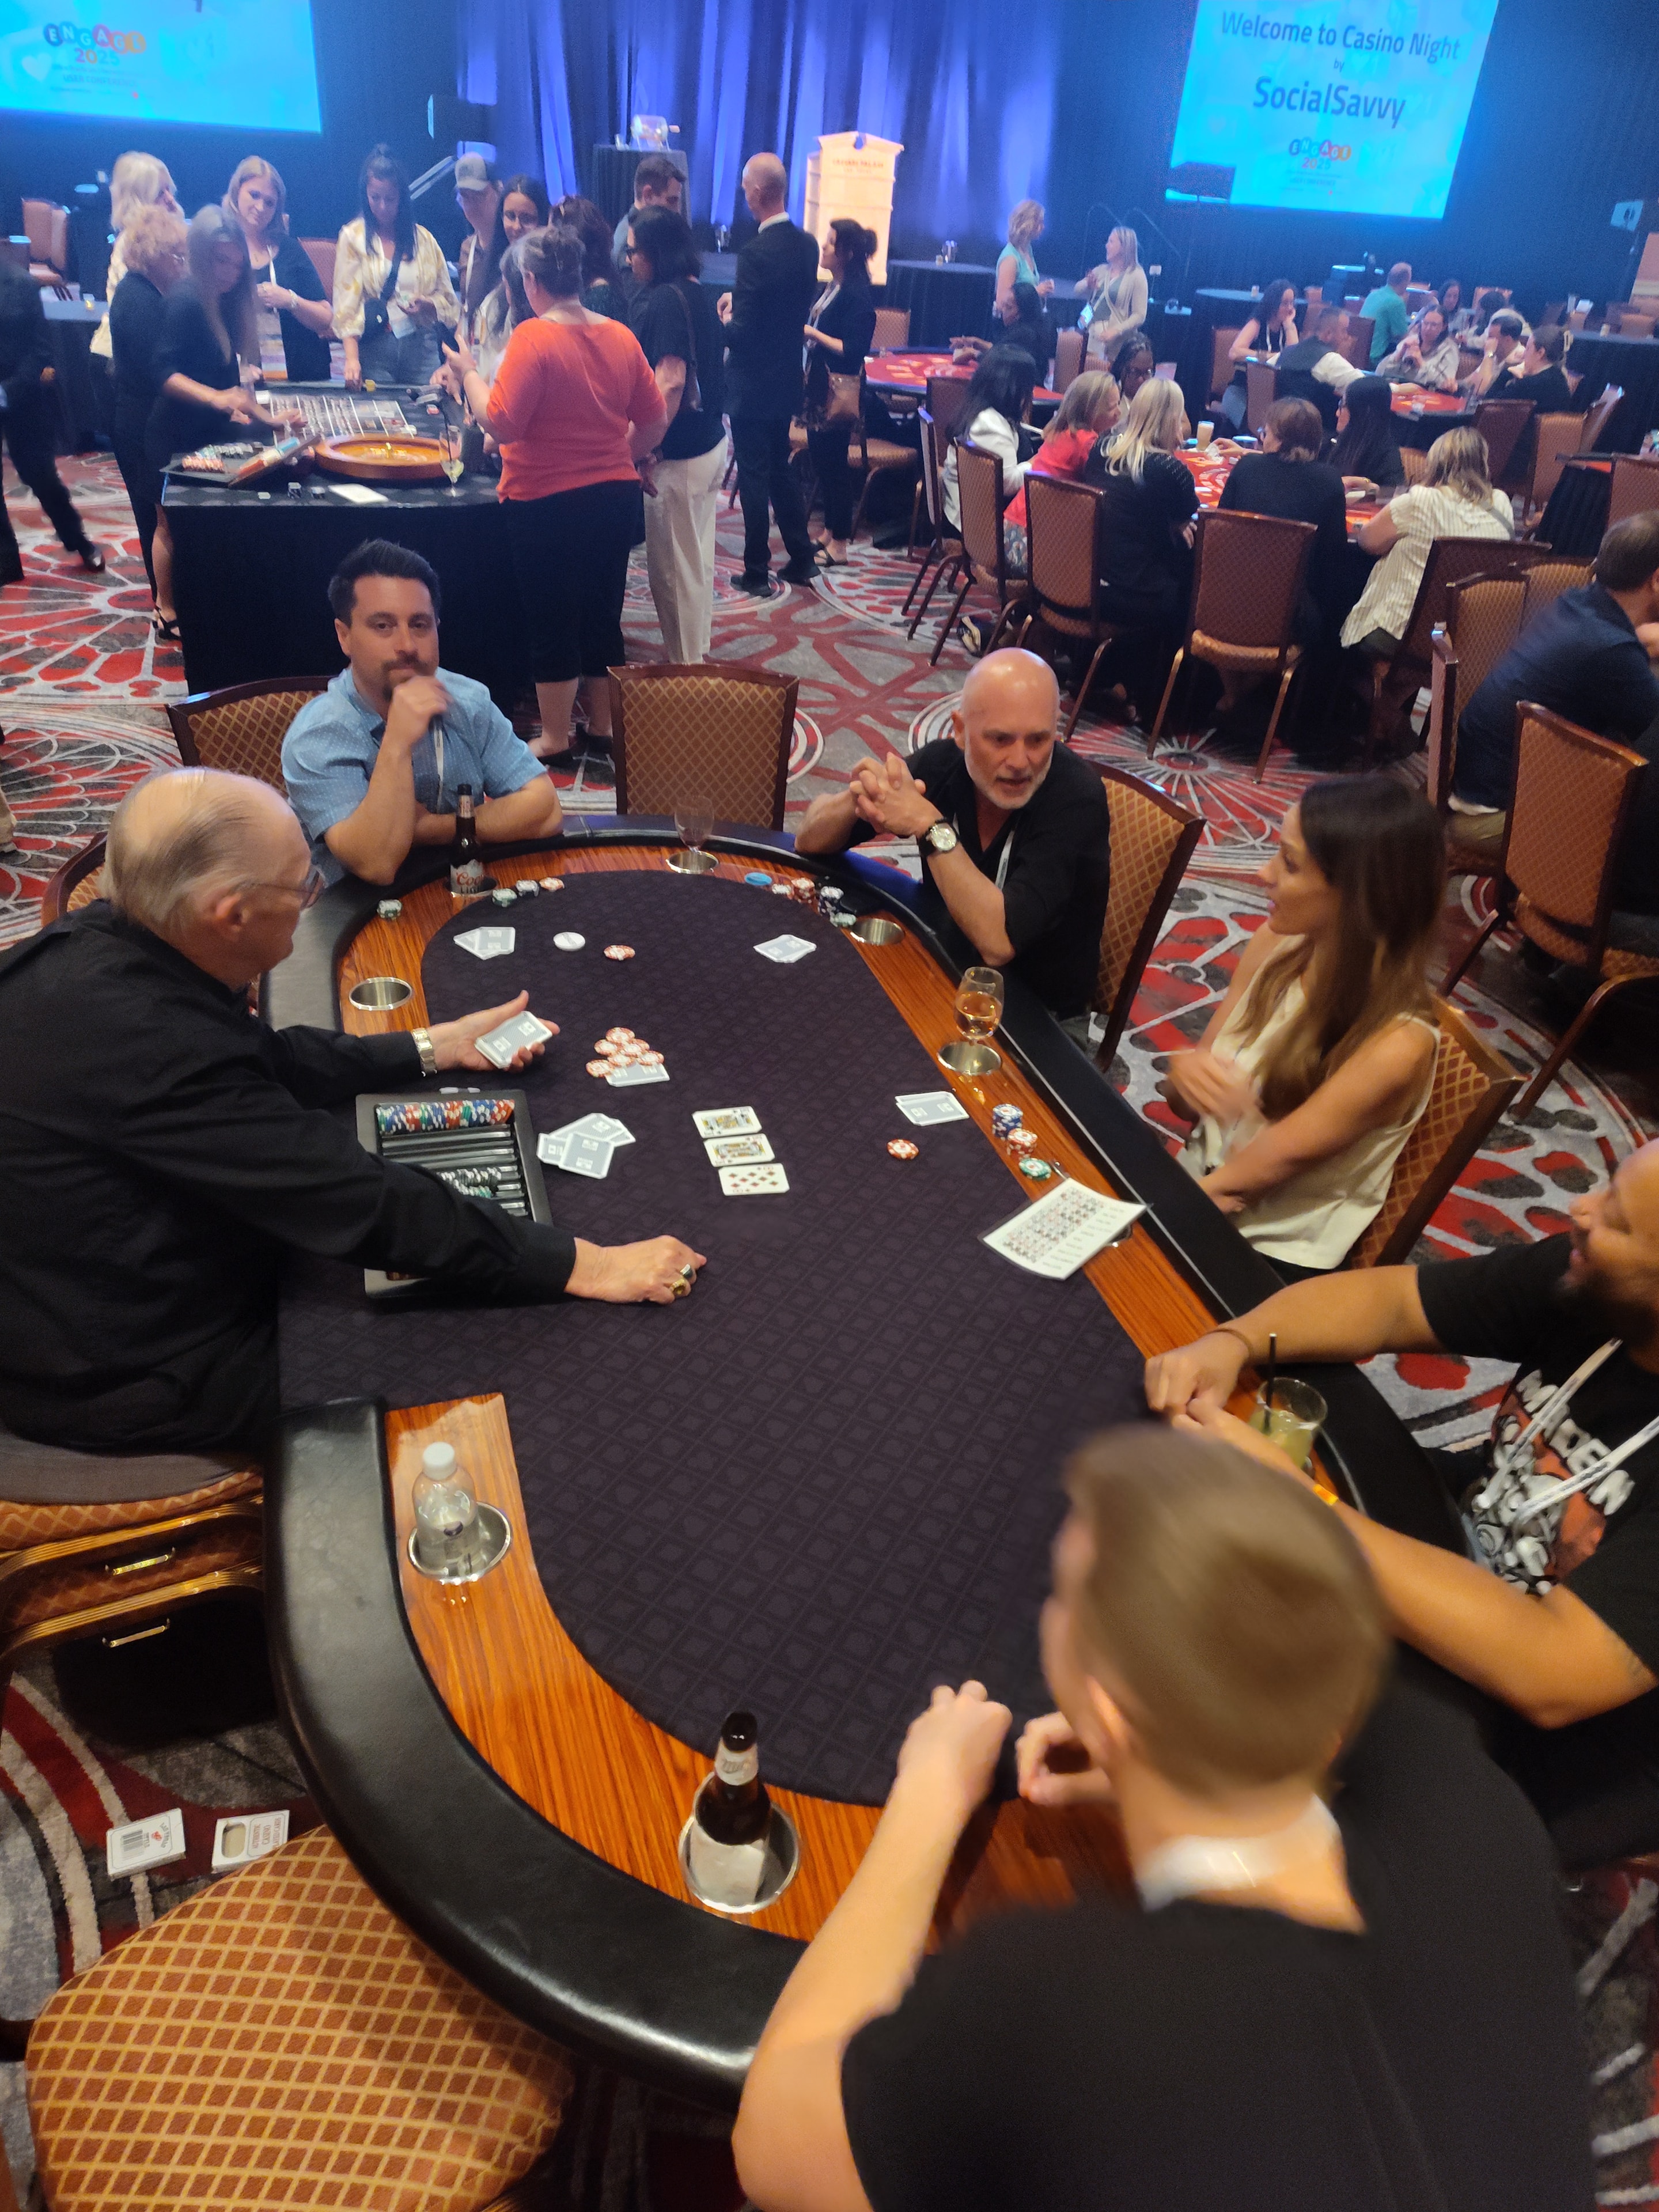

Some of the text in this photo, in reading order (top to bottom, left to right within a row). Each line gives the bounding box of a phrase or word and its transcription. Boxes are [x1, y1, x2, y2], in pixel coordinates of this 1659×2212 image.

[1221, 10, 1461, 65] Welcome to Casino Night
[74, 47, 120, 66] 2025
[1333, 58, 1345, 73] by
[1252, 75, 1407, 130] SocialSavvy
